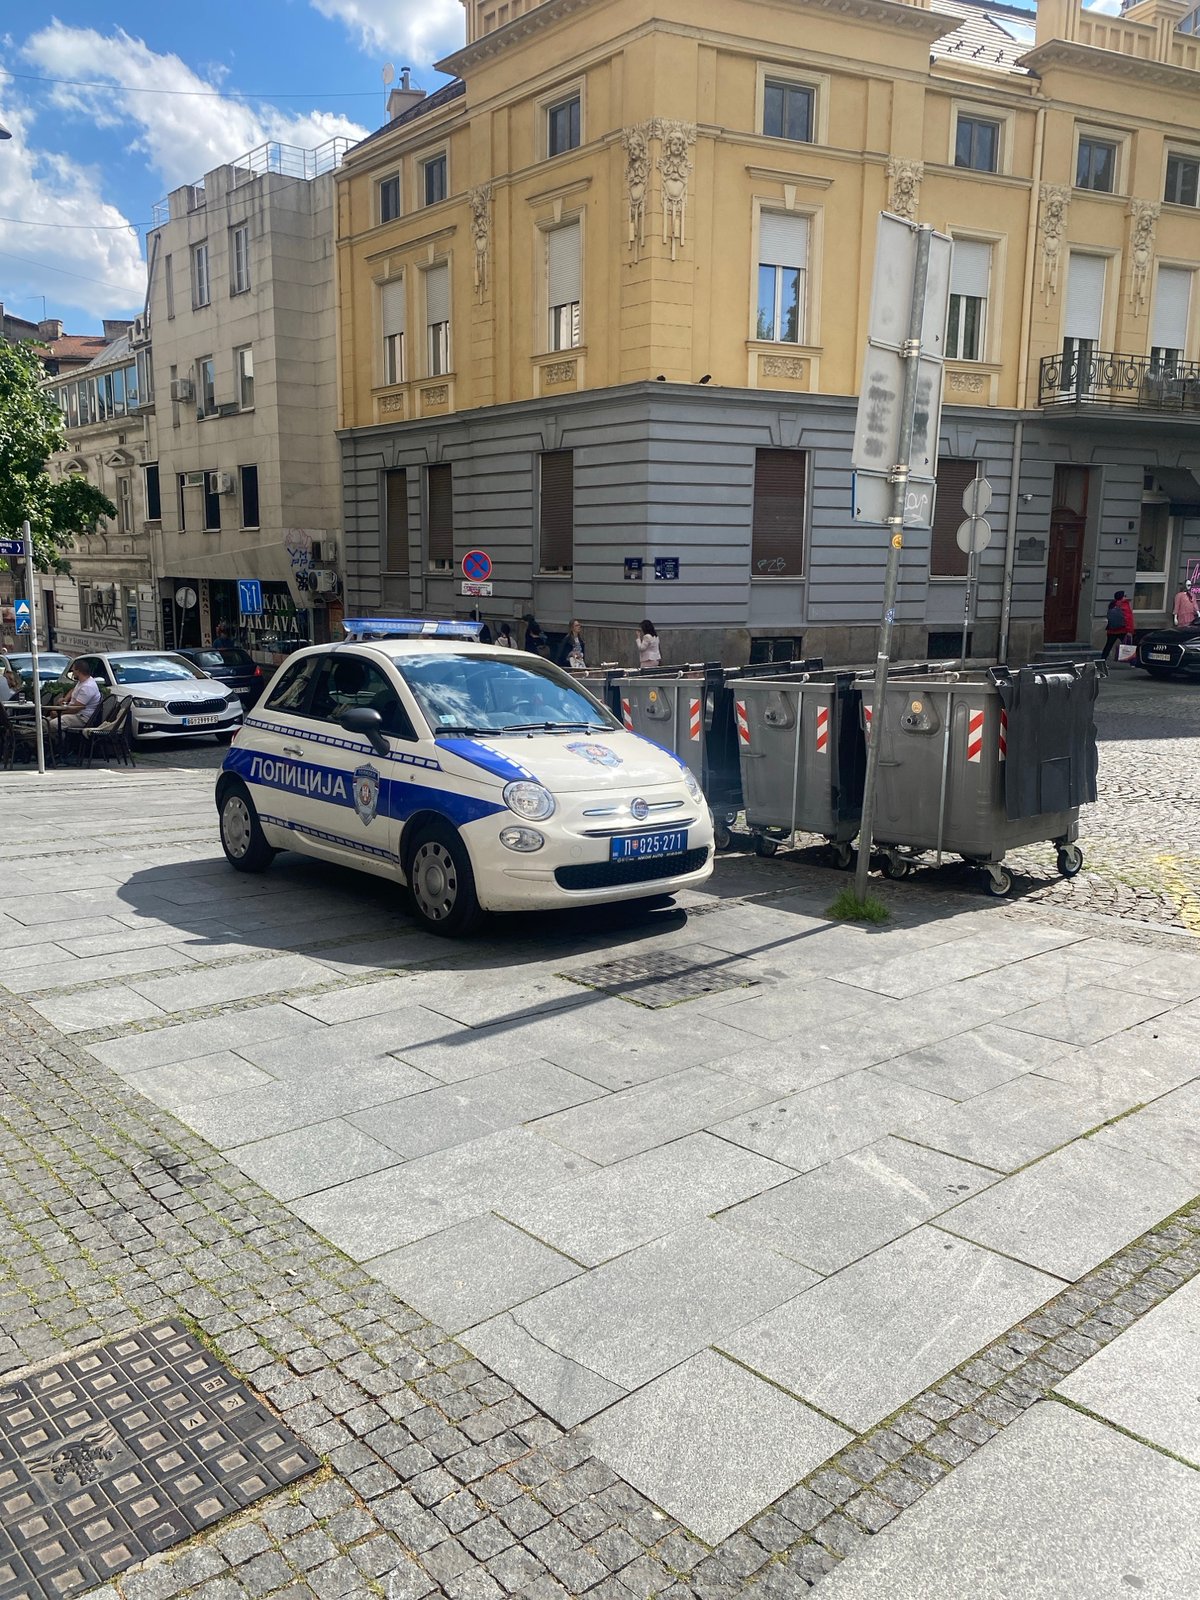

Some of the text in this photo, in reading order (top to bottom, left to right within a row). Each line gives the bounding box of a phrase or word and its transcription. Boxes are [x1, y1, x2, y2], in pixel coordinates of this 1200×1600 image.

[250, 756, 347, 799] ПОЛИЦИЈА
[624, 839, 631, 856] П
[227, 1398, 239, 1408] K
